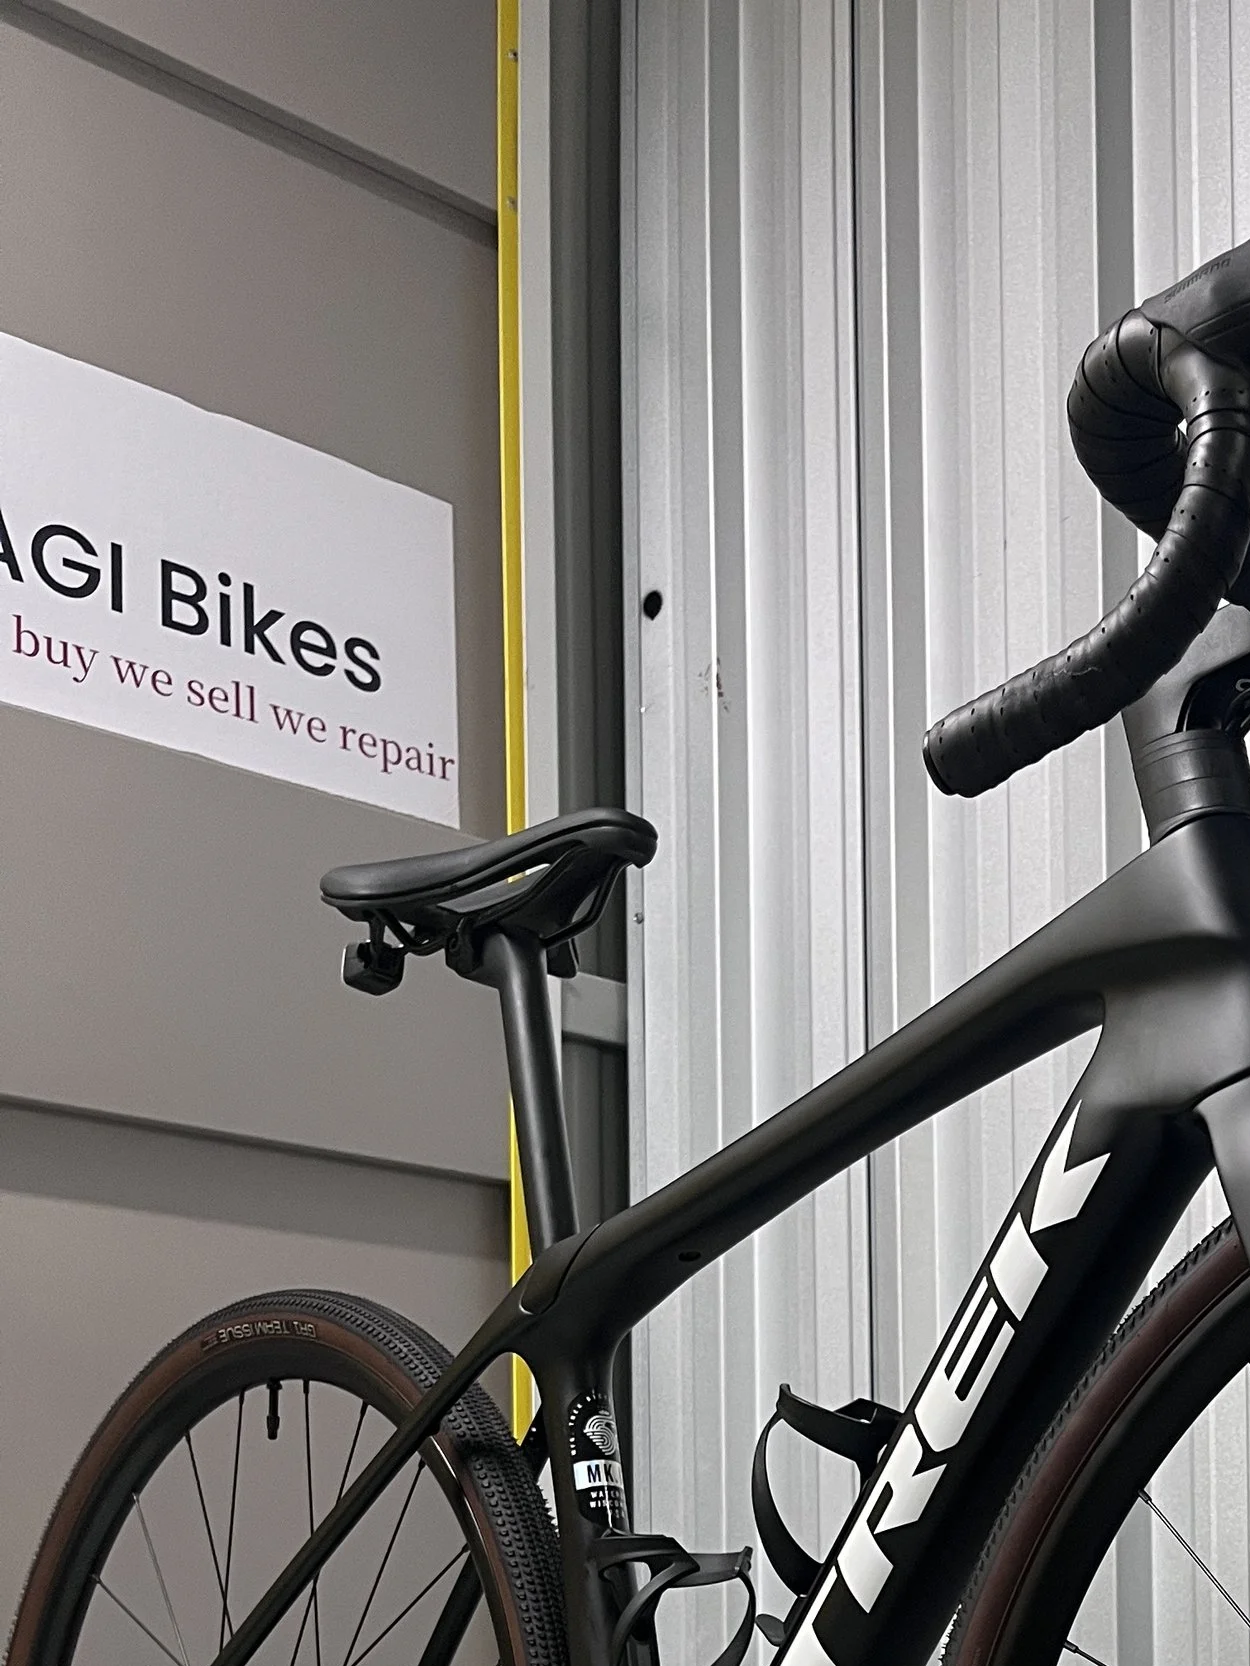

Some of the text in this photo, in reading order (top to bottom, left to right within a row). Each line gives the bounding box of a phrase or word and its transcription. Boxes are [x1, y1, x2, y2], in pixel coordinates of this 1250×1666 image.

[160, 558, 382, 693] Bikes
[12, 613, 456, 782] buy we sell we repair
[217, 1323, 254, 1343] ISSUE
[255, 1319, 291, 1336] TEAM
